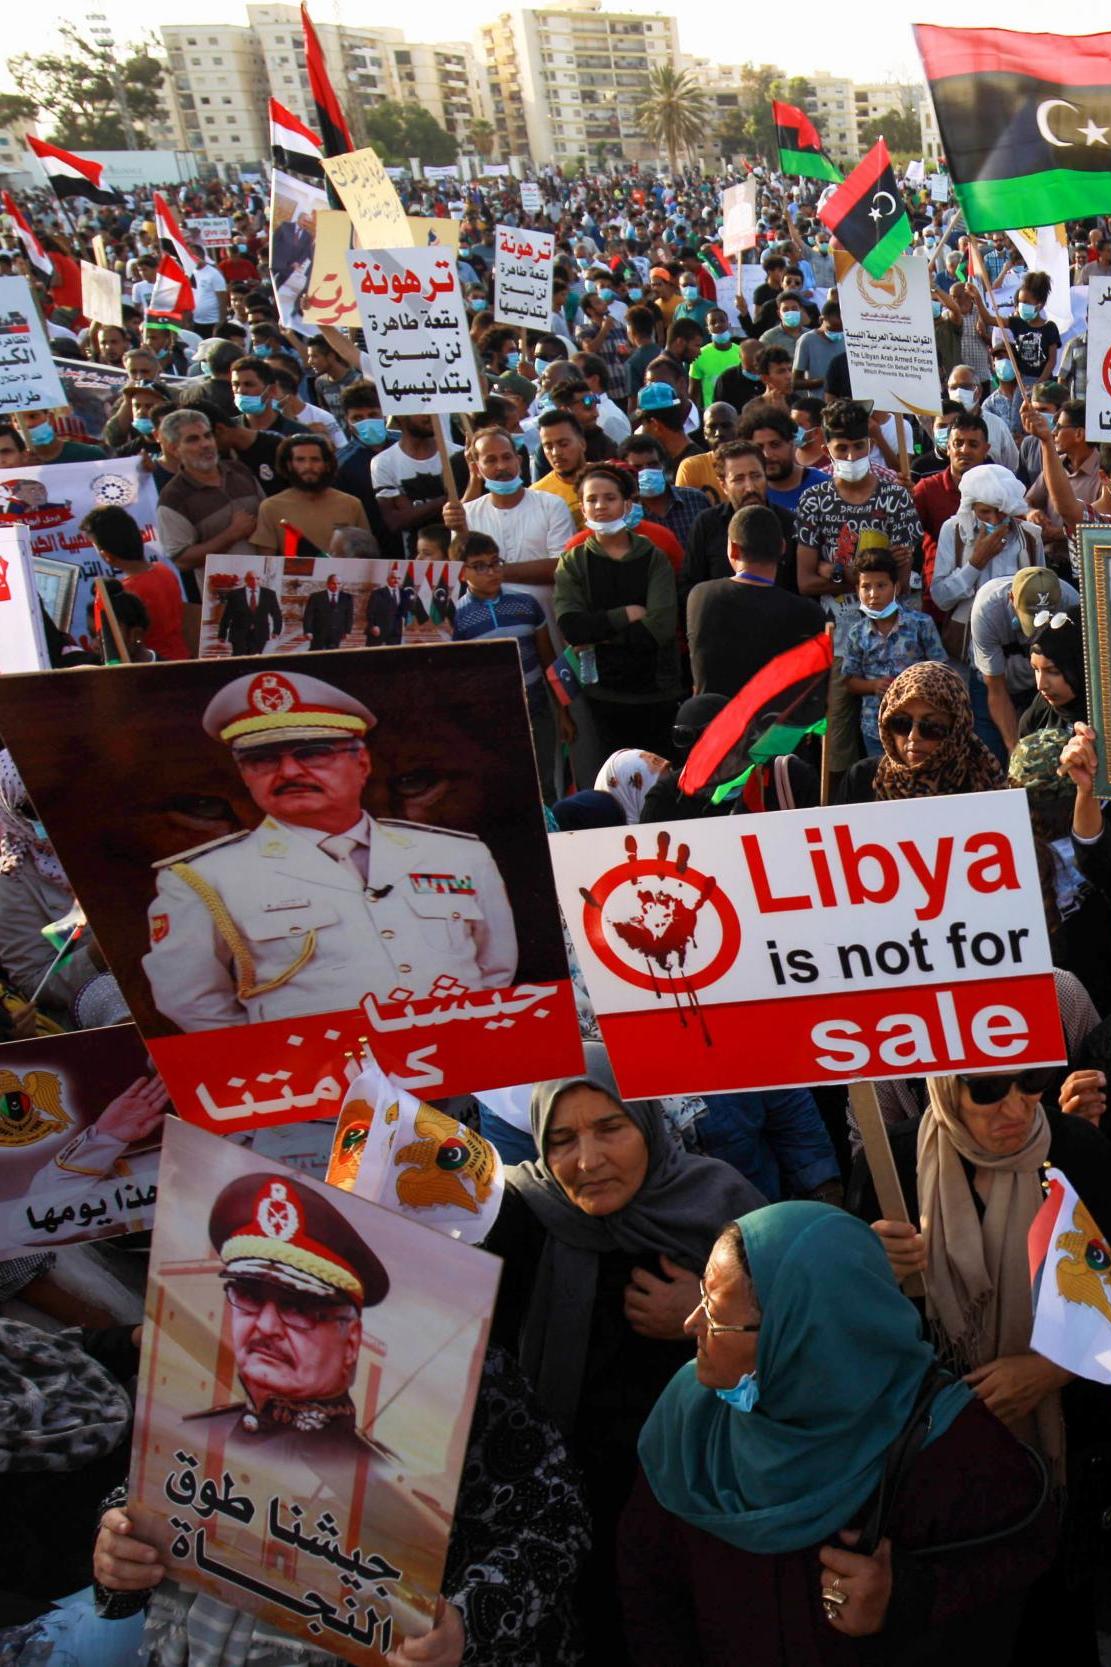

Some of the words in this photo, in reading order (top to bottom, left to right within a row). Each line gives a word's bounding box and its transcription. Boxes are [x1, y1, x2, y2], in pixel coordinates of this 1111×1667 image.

[500, 232, 552, 264] ترهونة
[353, 260, 455, 304] ترهونة
[500, 262, 527, 277] طاهرة
[529, 265, 549, 286] بقعة
[535, 288, 547, 301] لن
[368, 313, 419, 336] طاهرة
[420, 310, 459, 335] بقعة
[499, 299, 548, 325] بتدنيسها
[377, 341, 440, 368] نسمح
[444, 341, 462, 364] لن
[849, 350, 861, 358] The
[860, 351, 880, 361] Libyan
[880, 354, 894, 362] Arab
[894, 355, 913, 363] Armed
[913, 356, 934, 366] Forces
[381, 372, 474, 403] بتدنيسها
[740, 824, 1021, 921] Libya
[766, 939, 820, 986] is
[837, 925, 934, 980] not
[946, 921, 1030, 970] for
[359, 974, 559, 1034] جيشنا
[810, 990, 1031, 1073] sale
[195, 1043, 445, 1122] كامتنا
[26, 1196, 112, 1234] يومها
[163, 1448, 257, 1526] طوق
[267, 1495, 404, 1600] جيشنا
[169, 1516, 395, 1654] النجاة
